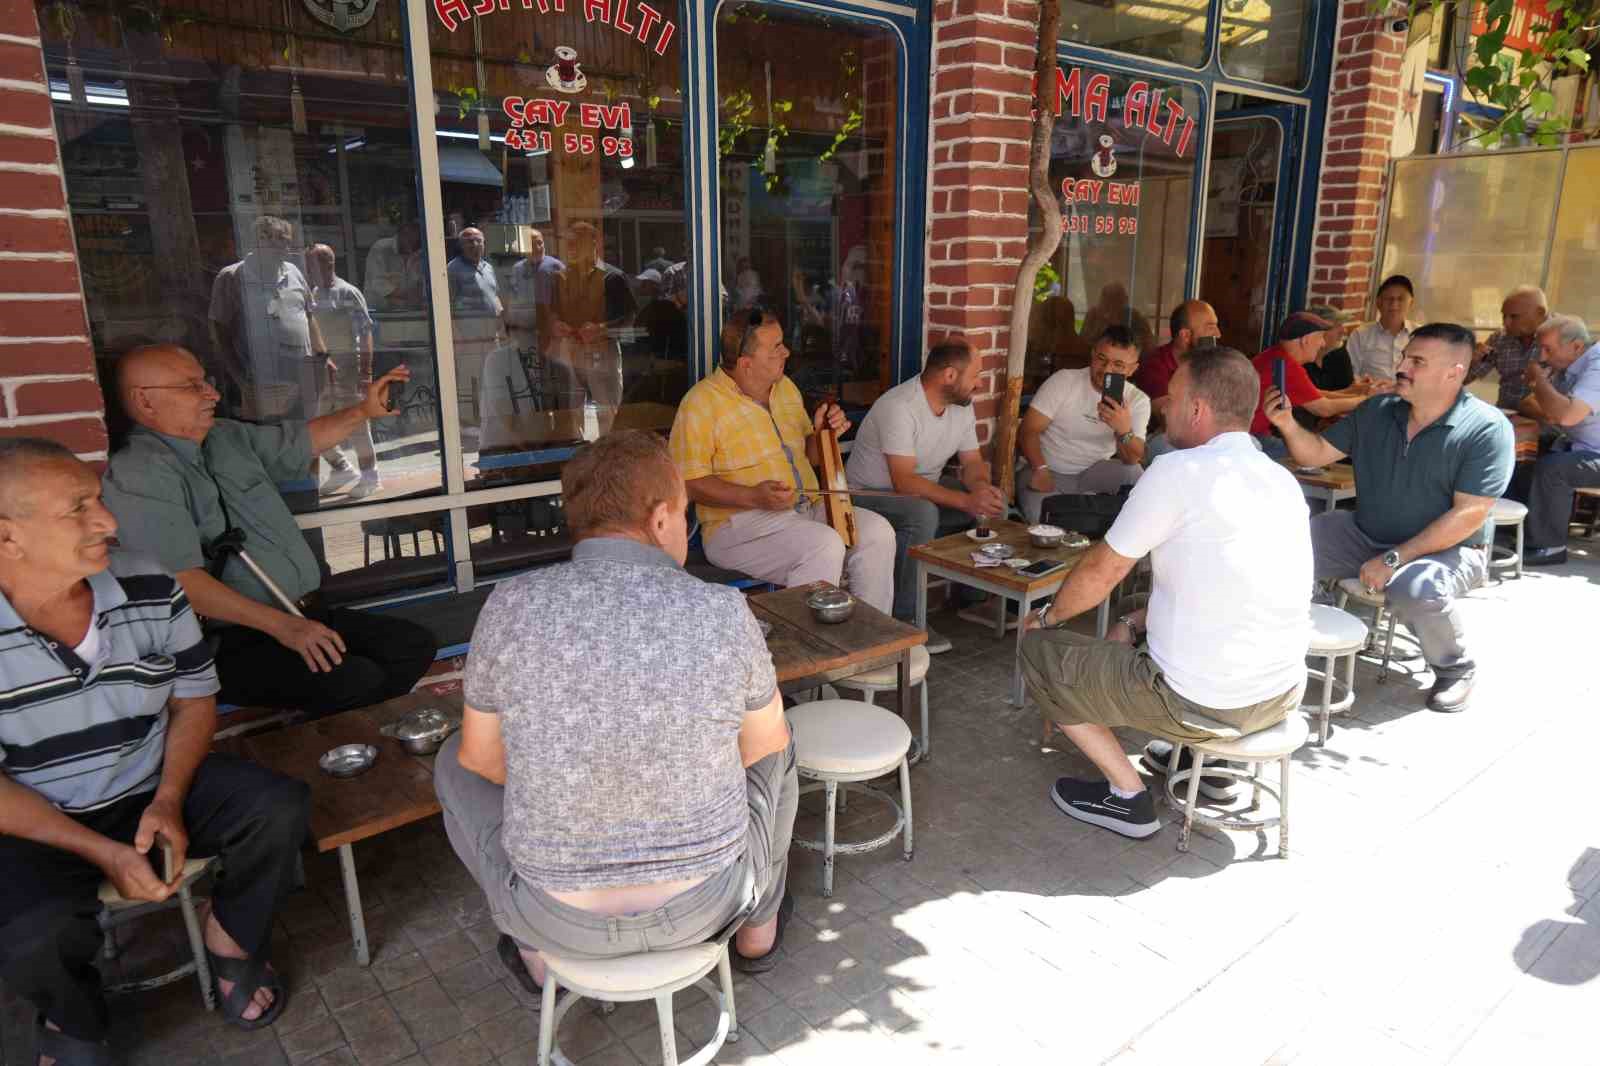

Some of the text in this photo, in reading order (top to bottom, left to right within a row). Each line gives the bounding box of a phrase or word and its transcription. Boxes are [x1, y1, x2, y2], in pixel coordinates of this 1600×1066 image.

[503, 96, 631, 129] ÇAY EVİ
[1031, 66, 1195, 158] MA ALTI
[504, 128, 633, 157] 431 55 93
[1062, 177, 1141, 206] ÇAY EVİ
[1060, 215, 1138, 235] 431 55 93
